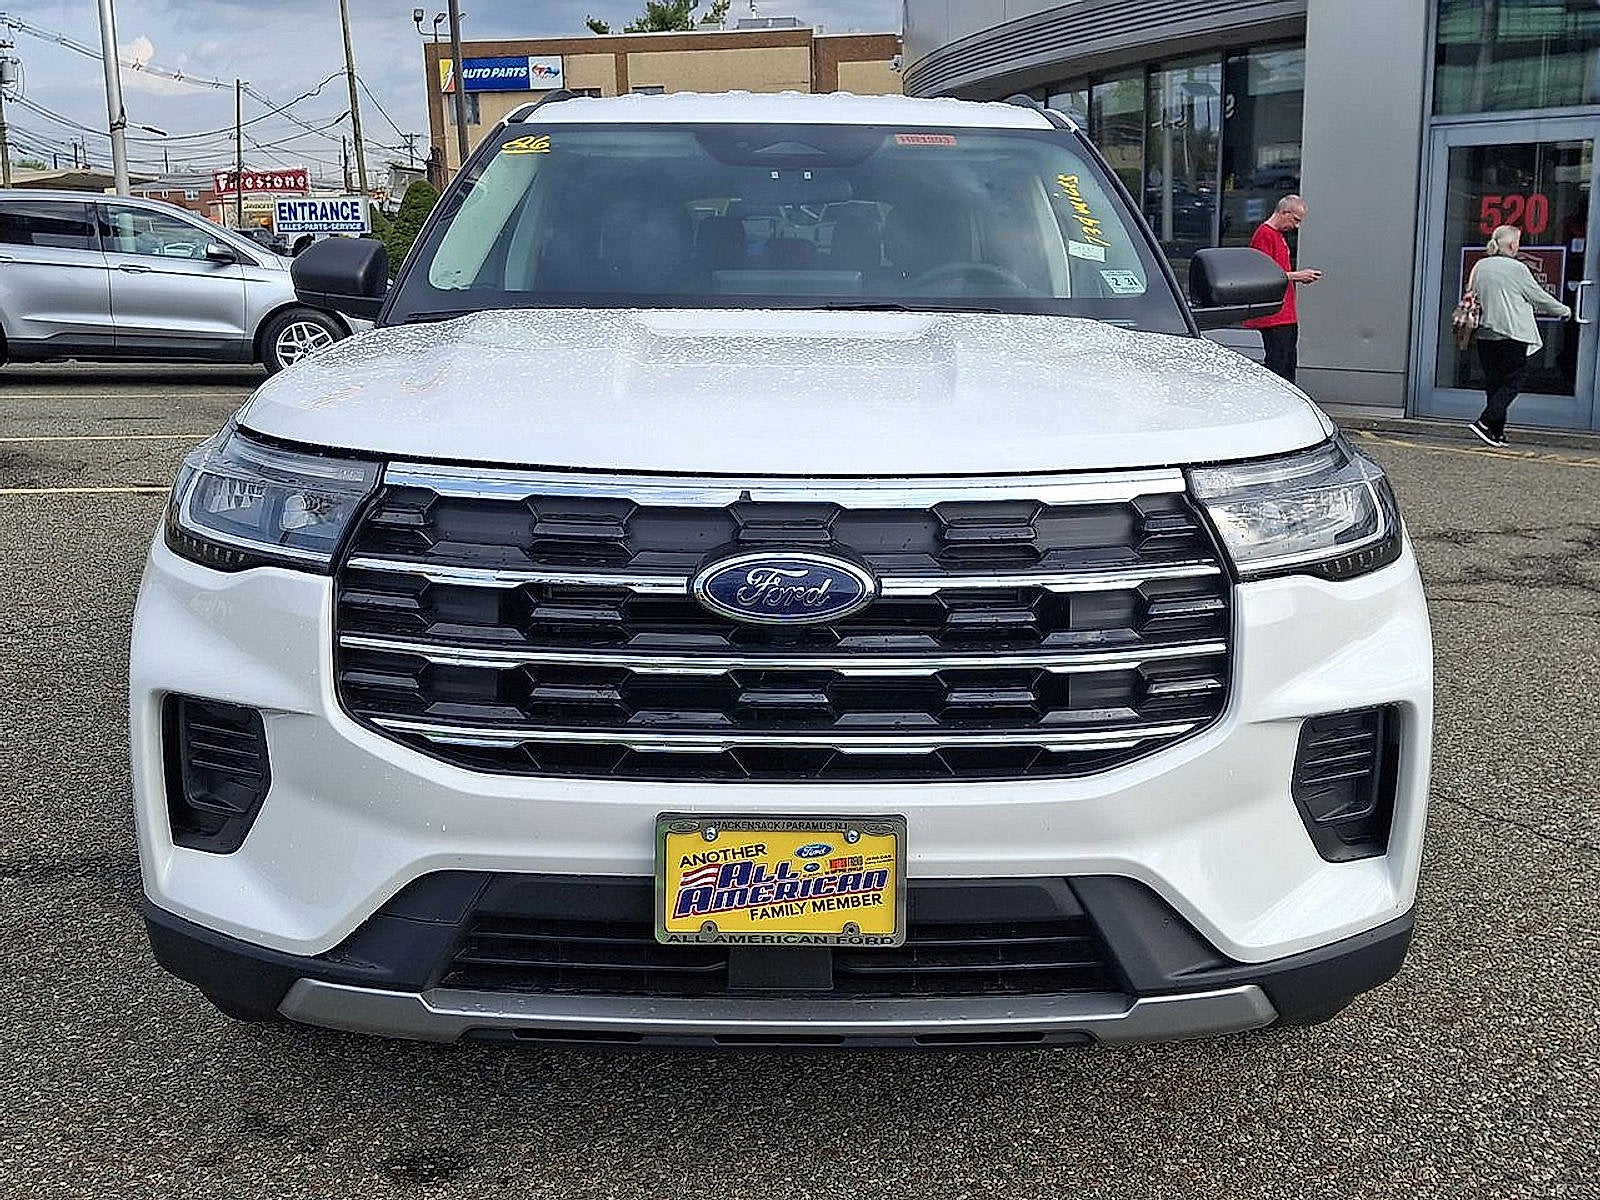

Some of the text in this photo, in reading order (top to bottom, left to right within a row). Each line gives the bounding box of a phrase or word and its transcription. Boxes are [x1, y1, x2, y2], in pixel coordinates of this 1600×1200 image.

[491, 67, 528, 78] PARTS
[277, 201, 361, 221] ENTRANCE
[1480, 193, 1549, 235] 520
[736, 566, 834, 607] Ford
[679, 843, 768, 869] ANOTHER
[718, 860, 800, 888] ALL
[675, 869, 888, 917] AMERICAN
[750, 893, 883, 921] FAMILY MEMBER
[667, 935, 895, 945] ALL AMERICAN FORD
